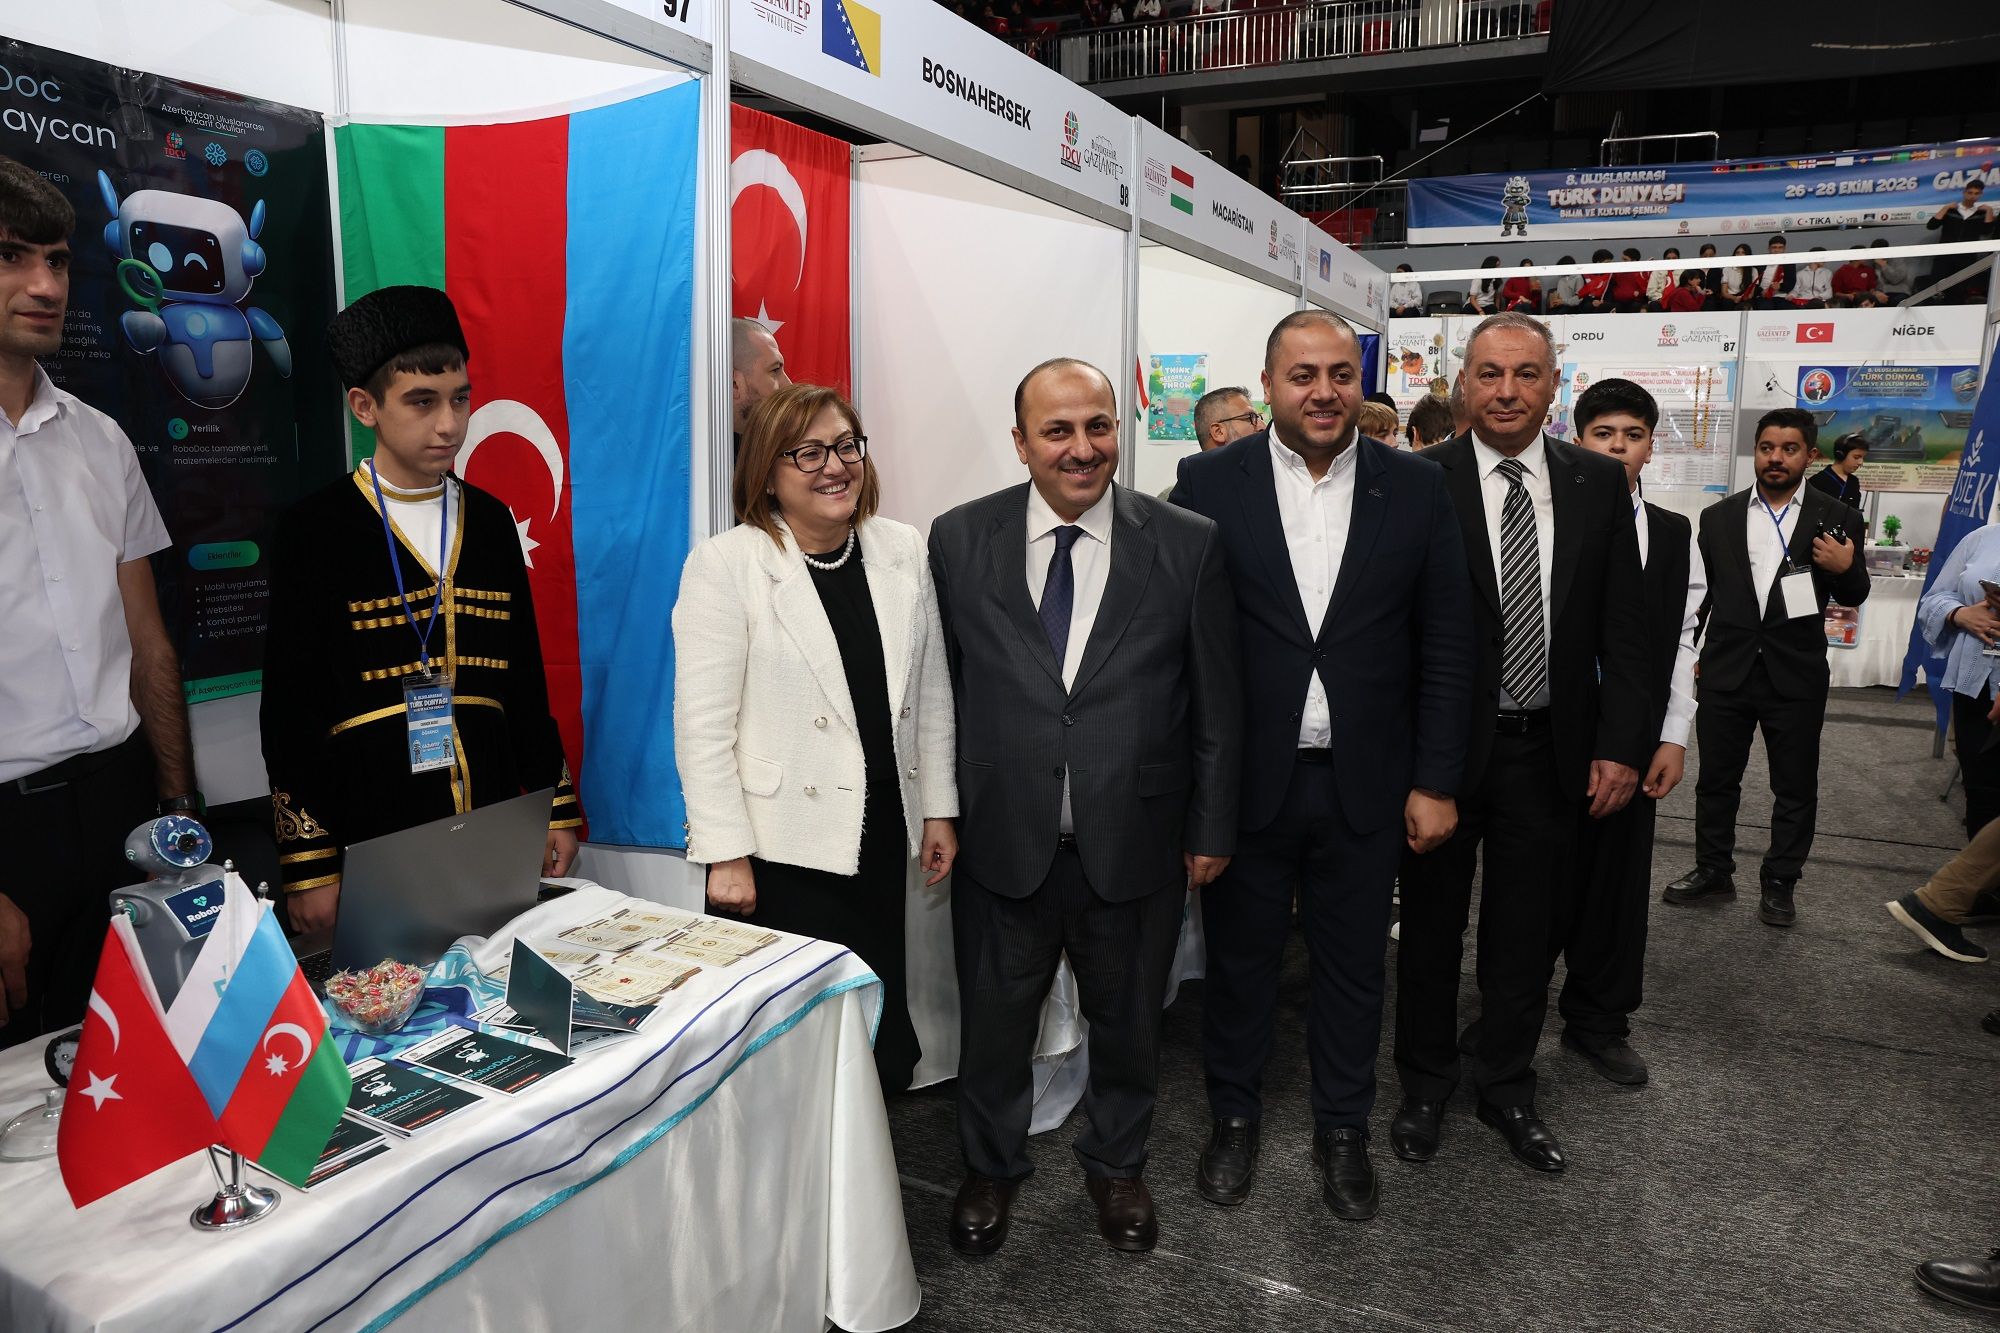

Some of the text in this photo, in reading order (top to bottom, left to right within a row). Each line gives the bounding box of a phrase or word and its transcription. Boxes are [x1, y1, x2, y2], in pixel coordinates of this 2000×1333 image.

[922, 56, 1032, 131] BOSNAHERSEK
[161, 103, 215, 121] Azerbaycan
[36, 169, 71, 184] eren
[1565, 170, 1666, 186] 8. ULUSLARARASI
[1120, 183, 1129, 208] 98
[1547, 183, 1685, 207] TÜRK DÜNYASI
[1785, 183, 1805, 198] 26
[1815, 181, 1837, 197] 28
[1212, 199, 1254, 235] MACARİSTAN
[1585, 208, 1596, 217] VE
[1572, 332, 1605, 341] ORDU
[1892, 324, 1936, 337] NİĞDE
[1428, 346, 1439, 355] 88
[1723, 342, 1736, 352] 87
[192, 424, 221, 433] Yerlilik
[172, 444, 210, 453] RoboDoc
[204, 581, 226, 592] Mobil
[206, 615, 236, 627] Kontrol
[465, 1054, 517, 1080] RoboDoc
[366, 1088, 425, 1117] RoboDoc
